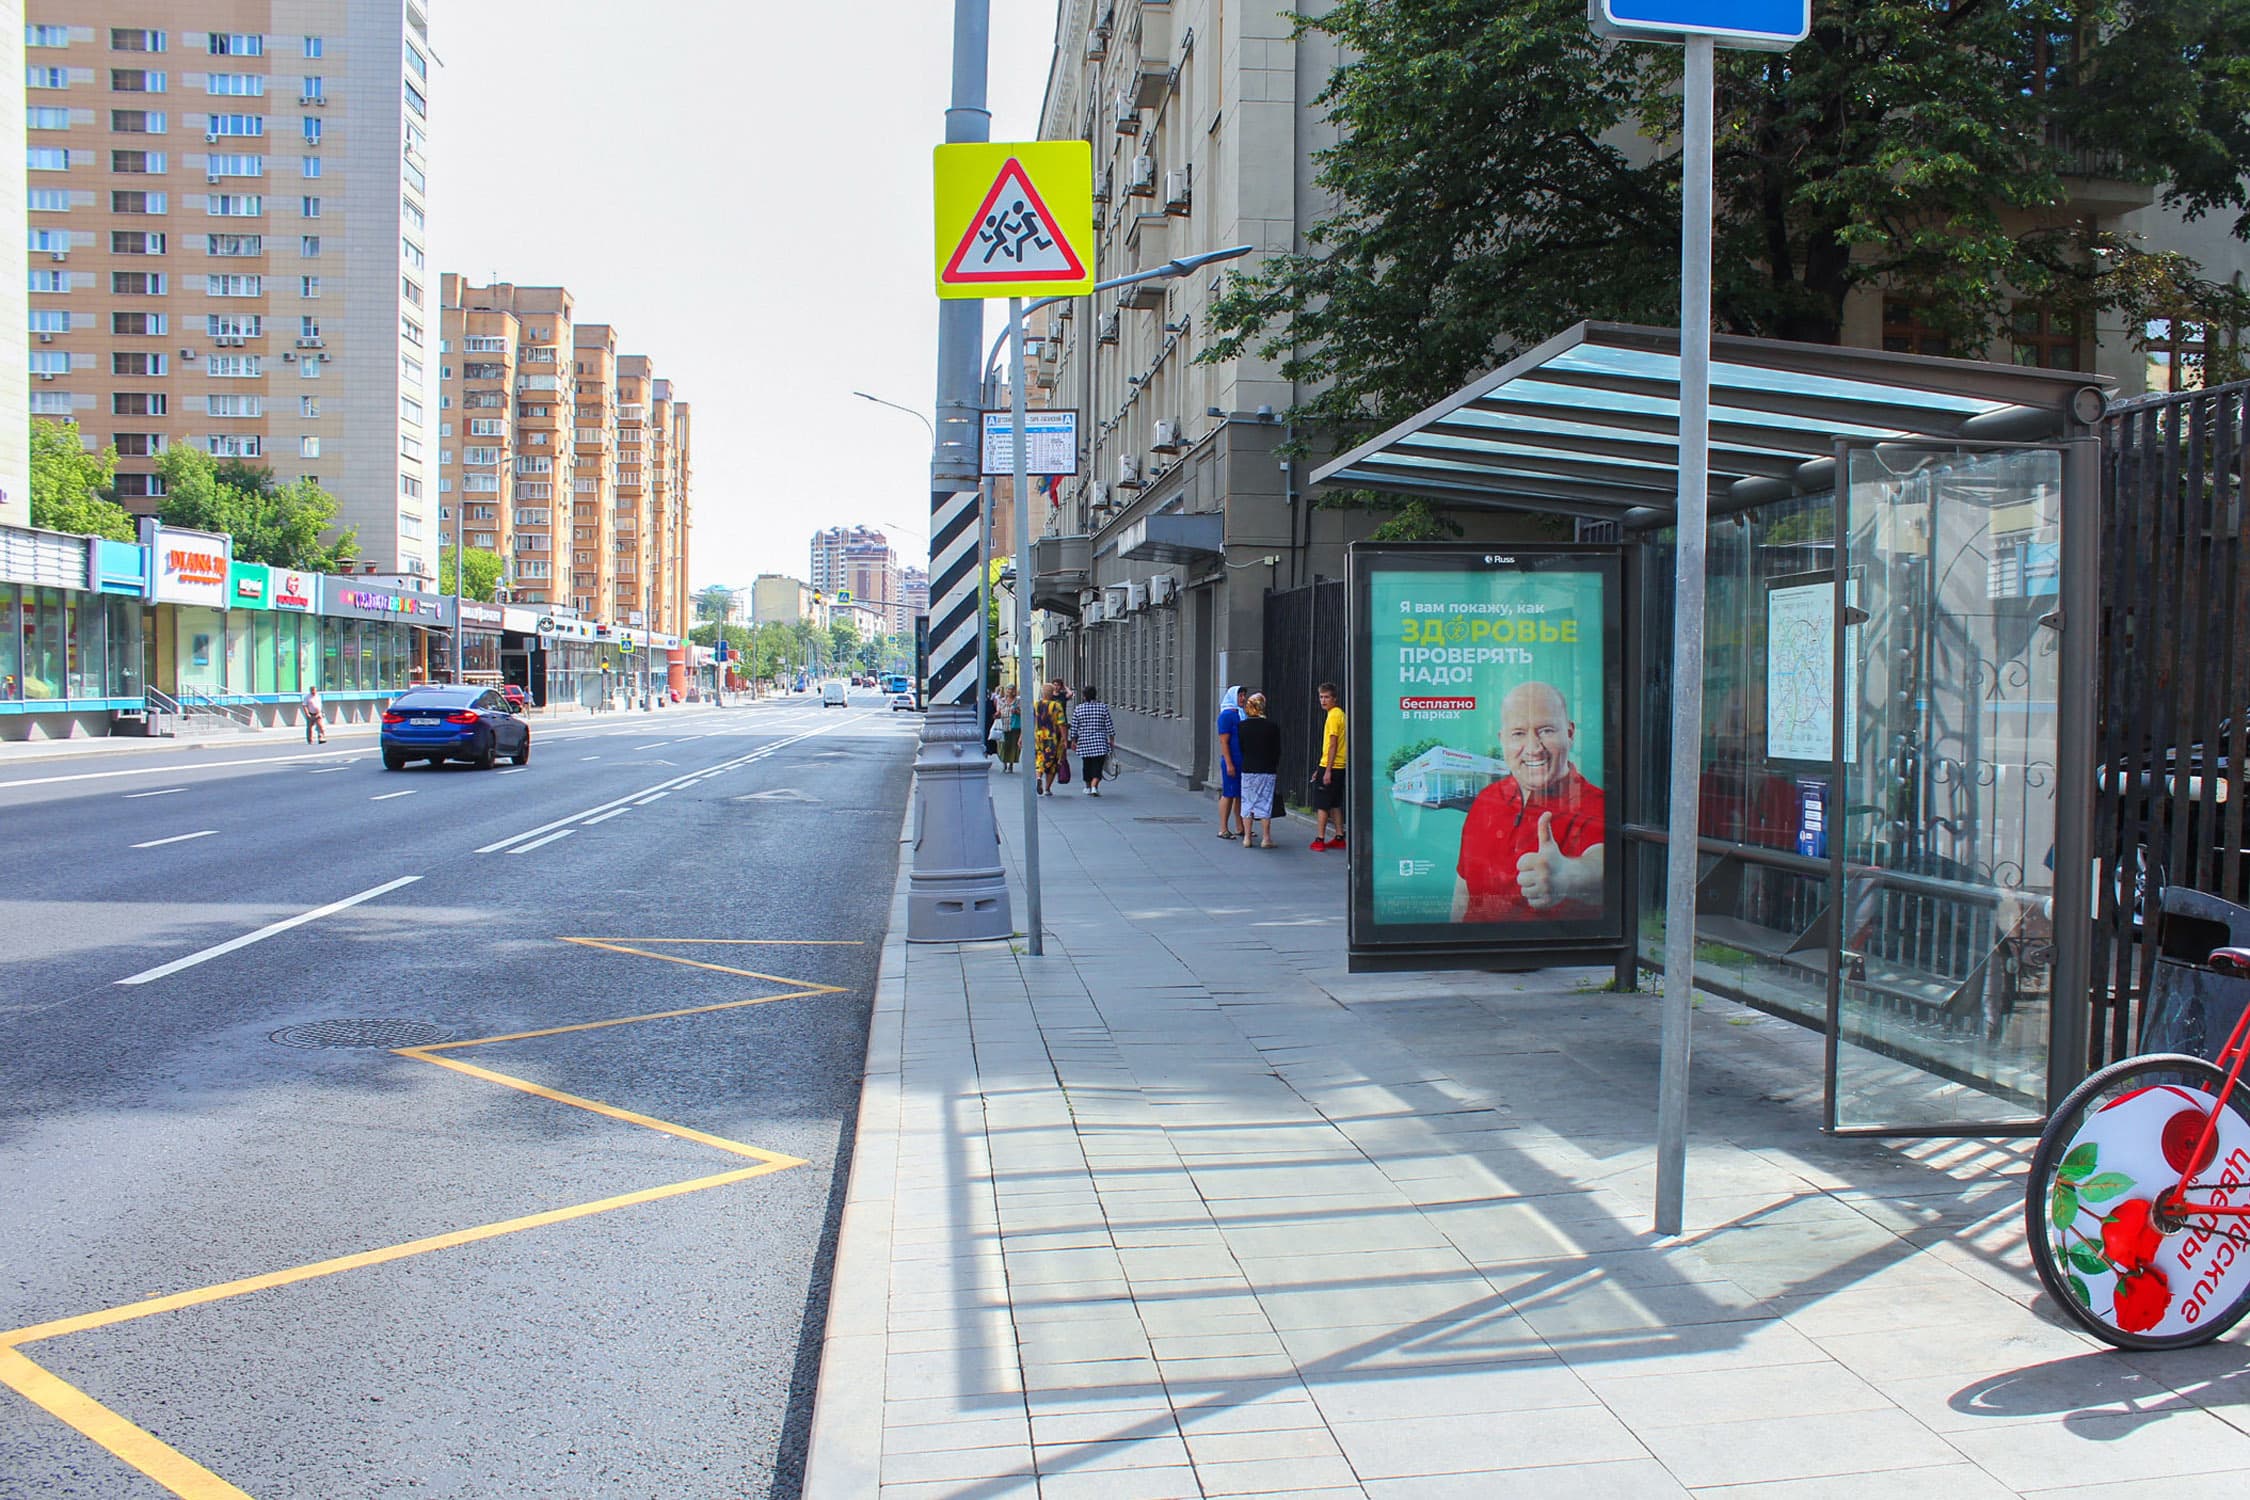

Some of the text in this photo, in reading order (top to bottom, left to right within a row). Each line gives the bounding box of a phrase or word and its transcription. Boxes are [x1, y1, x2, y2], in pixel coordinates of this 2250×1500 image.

[1494, 555, 1516, 564] Russ
[1400, 600, 1545, 617] Я вам покажу, как
[1400, 647, 1534, 664] ПРОВЕРЯТЬ
[1400, 667, 1473, 686] НАДО!
[1402, 698, 1474, 710] бесплатно
[1402, 710, 1461, 722] в парках
[2177, 1147, 2250, 1270] цветы
